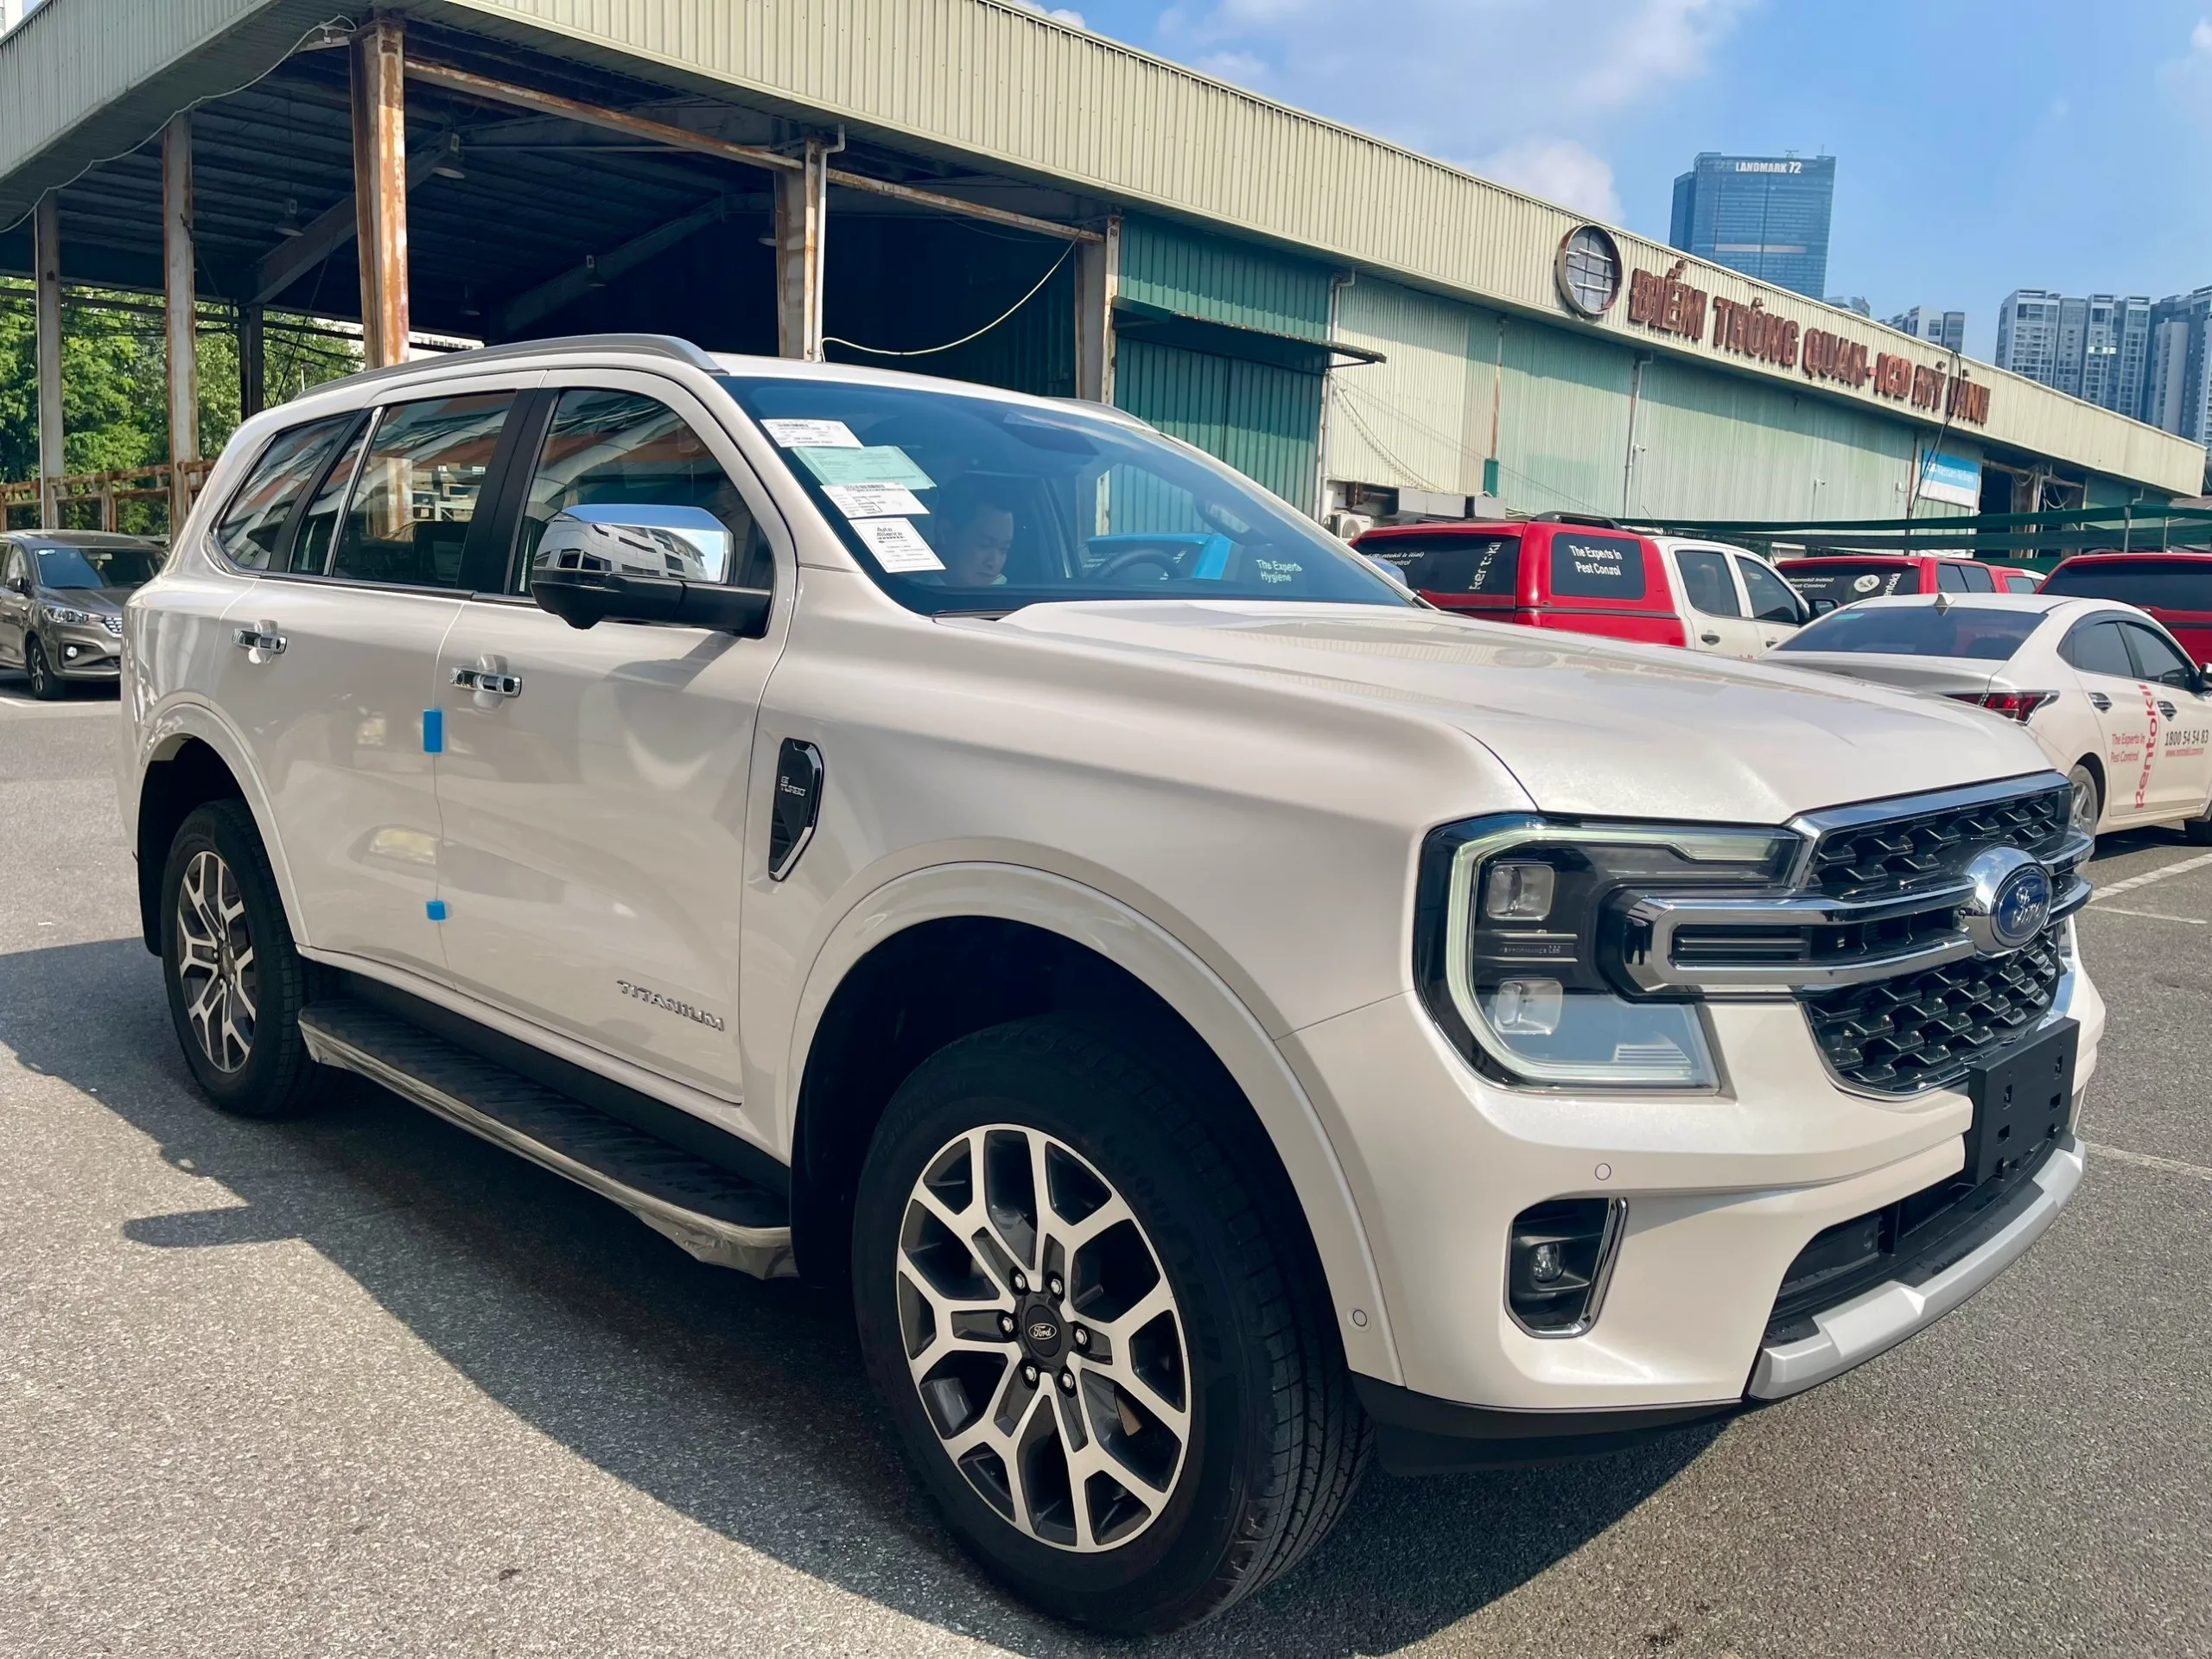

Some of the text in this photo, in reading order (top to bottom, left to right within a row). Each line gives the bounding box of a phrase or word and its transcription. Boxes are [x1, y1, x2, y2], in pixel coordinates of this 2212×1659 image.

[1735, 161, 1802, 174] LANDMARK 72
[1713, 296, 1800, 366] THÔNG
[1569, 544, 1586, 557] The
[1584, 546, 1613, 561] Experts
[1255, 559, 1303, 573] The Experts
[1575, 561, 1622, 576] Pest Control
[1260, 570, 1293, 583] Hygiene
[1884, 573, 1901, 596] entokil
[2164, 728, 2209, 747] 1800 54 54 83
[2135, 684, 2158, 809] Rentokil
[779, 783, 806, 797] TURBO
[616, 980, 725, 1032] TITANIUM
[1033, 1325, 1052, 1337] Ford
